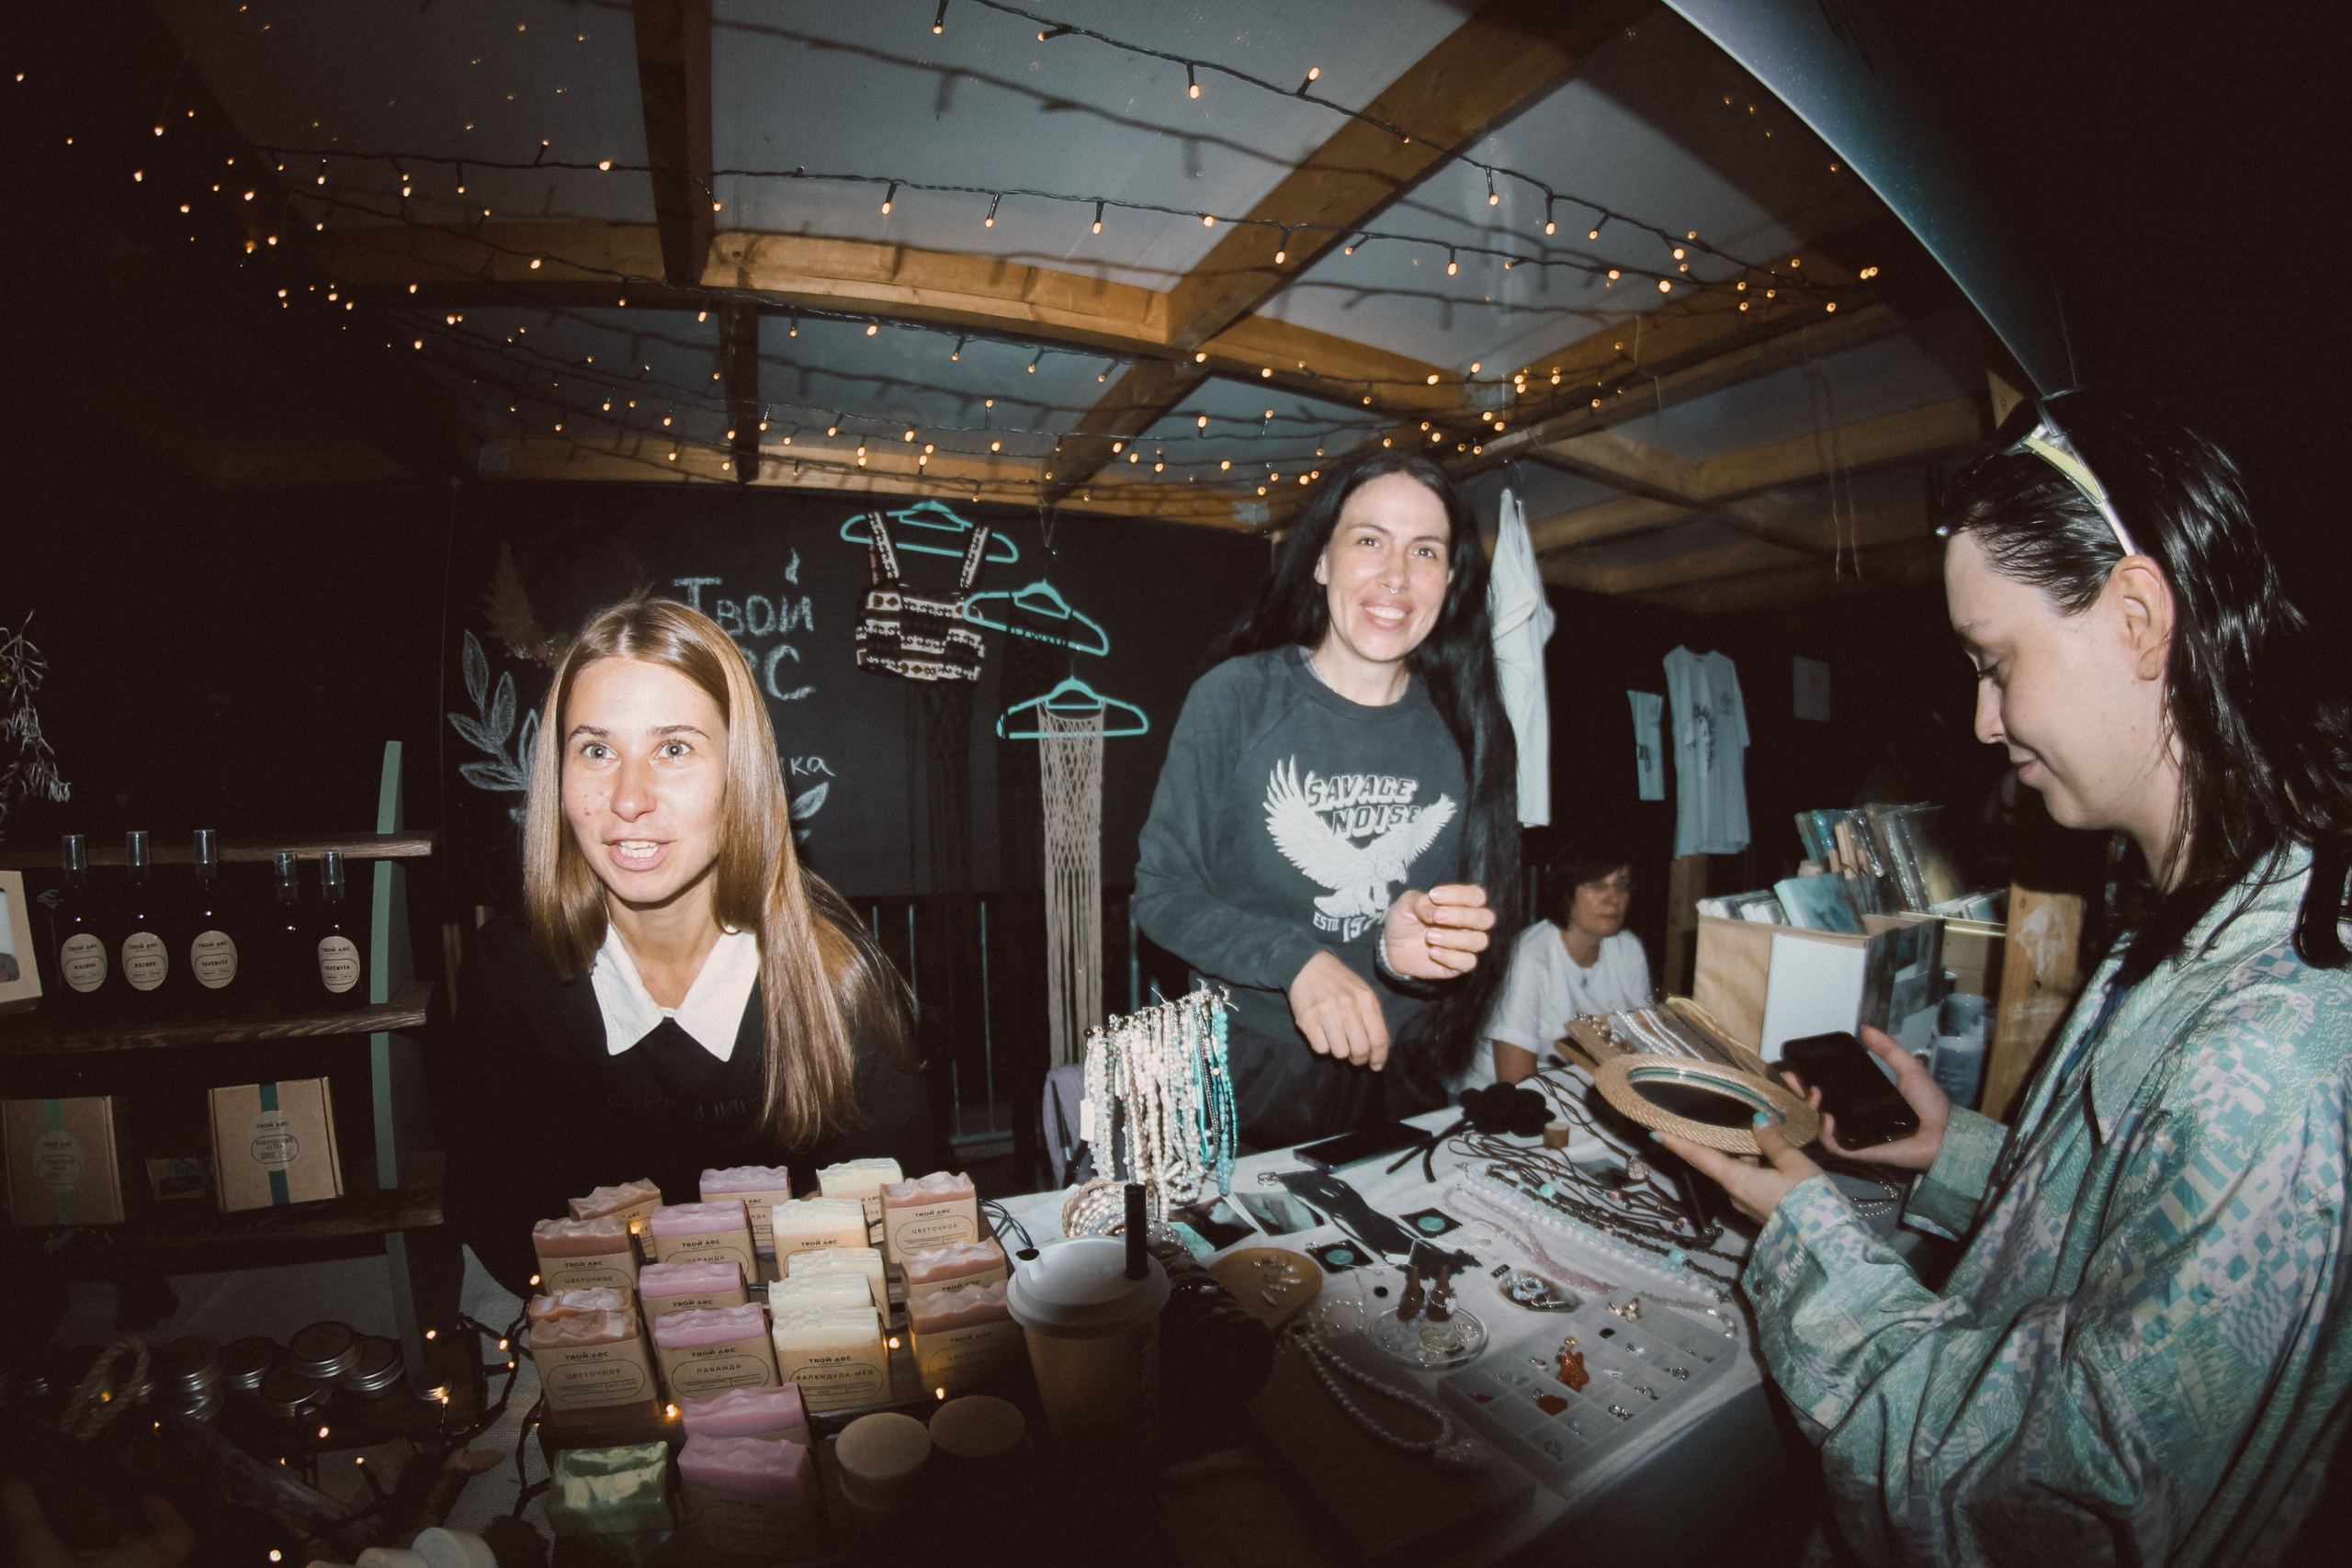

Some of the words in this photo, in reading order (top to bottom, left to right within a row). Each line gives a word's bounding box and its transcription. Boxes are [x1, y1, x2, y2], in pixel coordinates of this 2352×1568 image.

[1307, 775, 1418, 809] SAVAGE
[1331, 806, 1421, 837] NOISE
[911, 1224, 957, 1234] ЦВЕТОЧНОЕ
[564, 1276, 614, 1284] ЦВЕТОЧНОЕ
[696, 1364, 741, 1374] ЛАВАНДА
[565, 1369, 622, 1380] ЦВЕТОЧНОЕ
